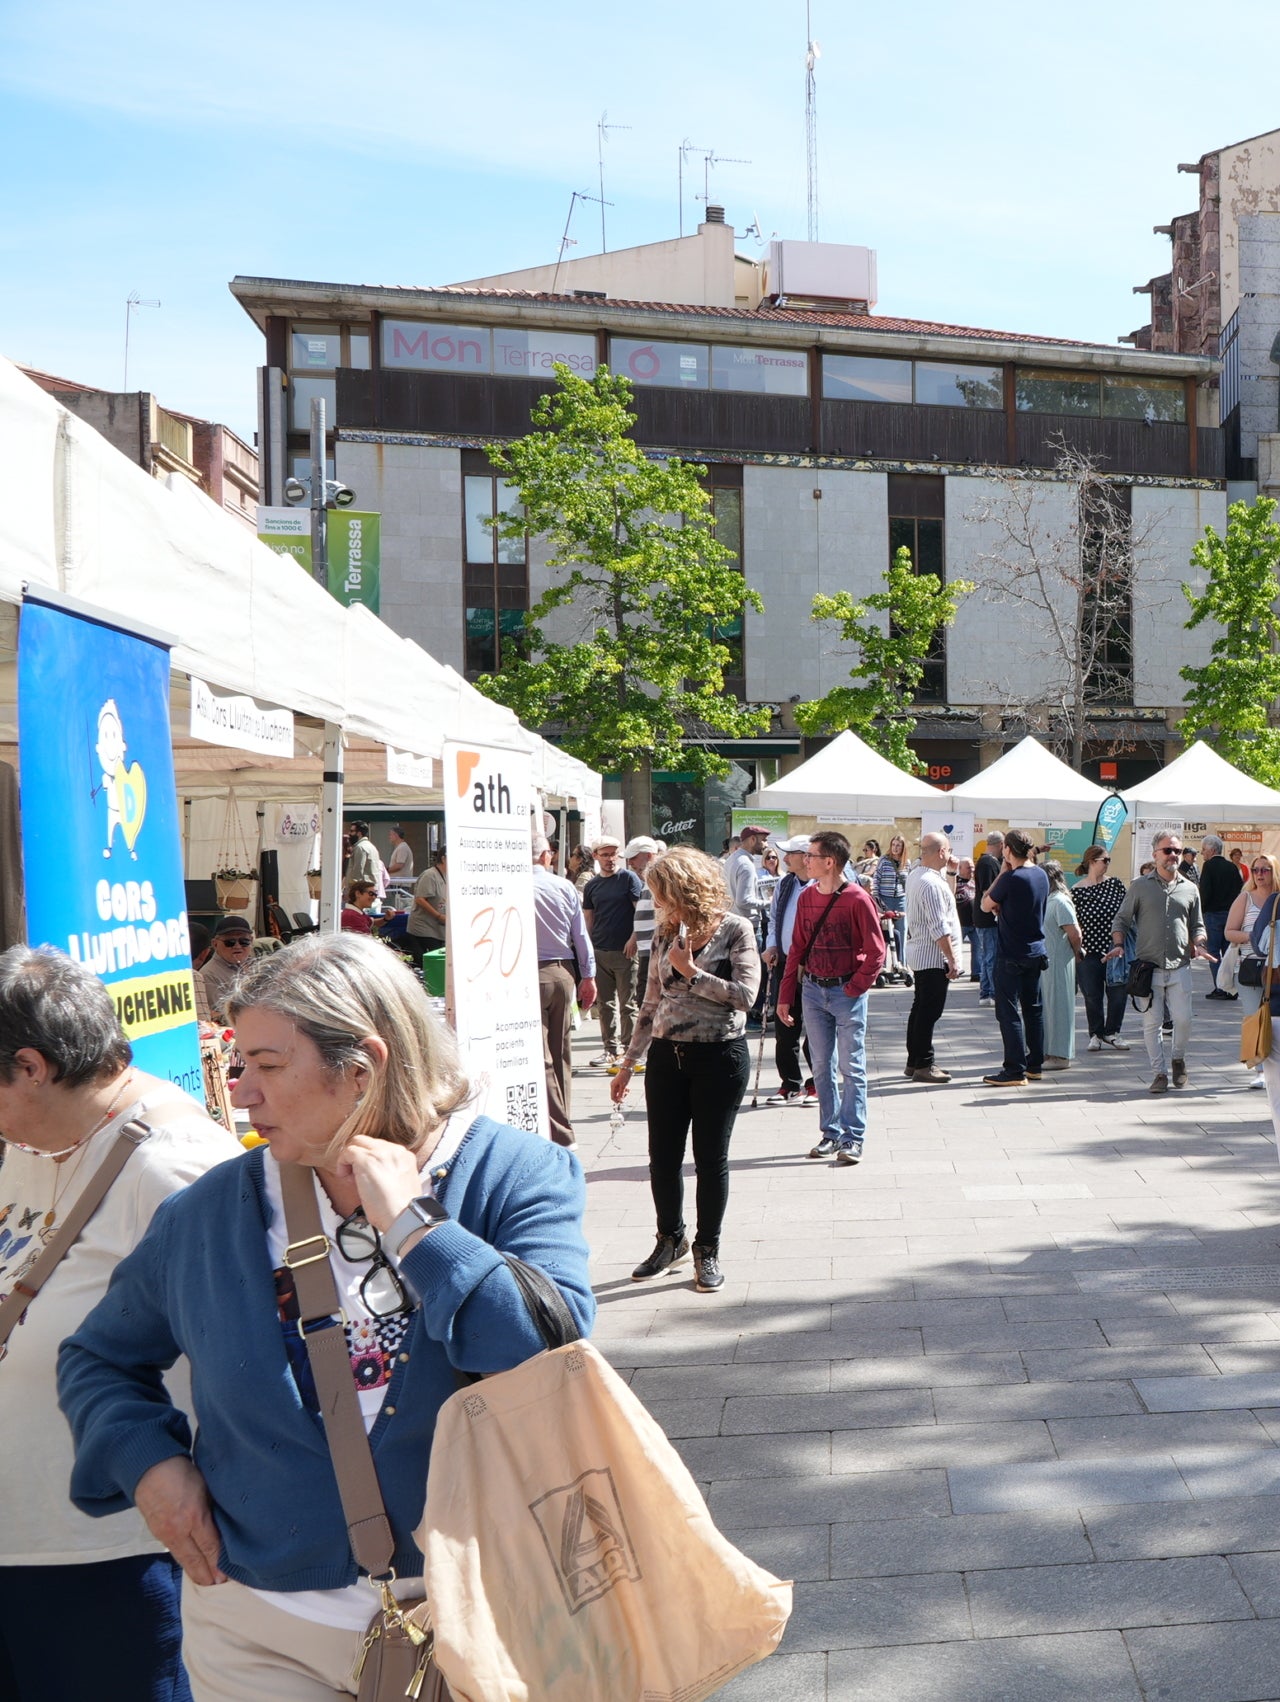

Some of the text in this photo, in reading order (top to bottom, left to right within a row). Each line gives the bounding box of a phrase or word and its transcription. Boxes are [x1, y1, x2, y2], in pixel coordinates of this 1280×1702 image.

[496, 344, 594, 371] Terrassa
[290, 544, 305, 554] no
[344, 519, 362, 593] Terrassa
[661, 818, 697, 836] Cottet
[95, 878, 157, 922] CORS
[466, 905, 523, 983] 30
[495, 1038, 525, 1054] pacients
[499, 1056, 529, 1070] familiars
